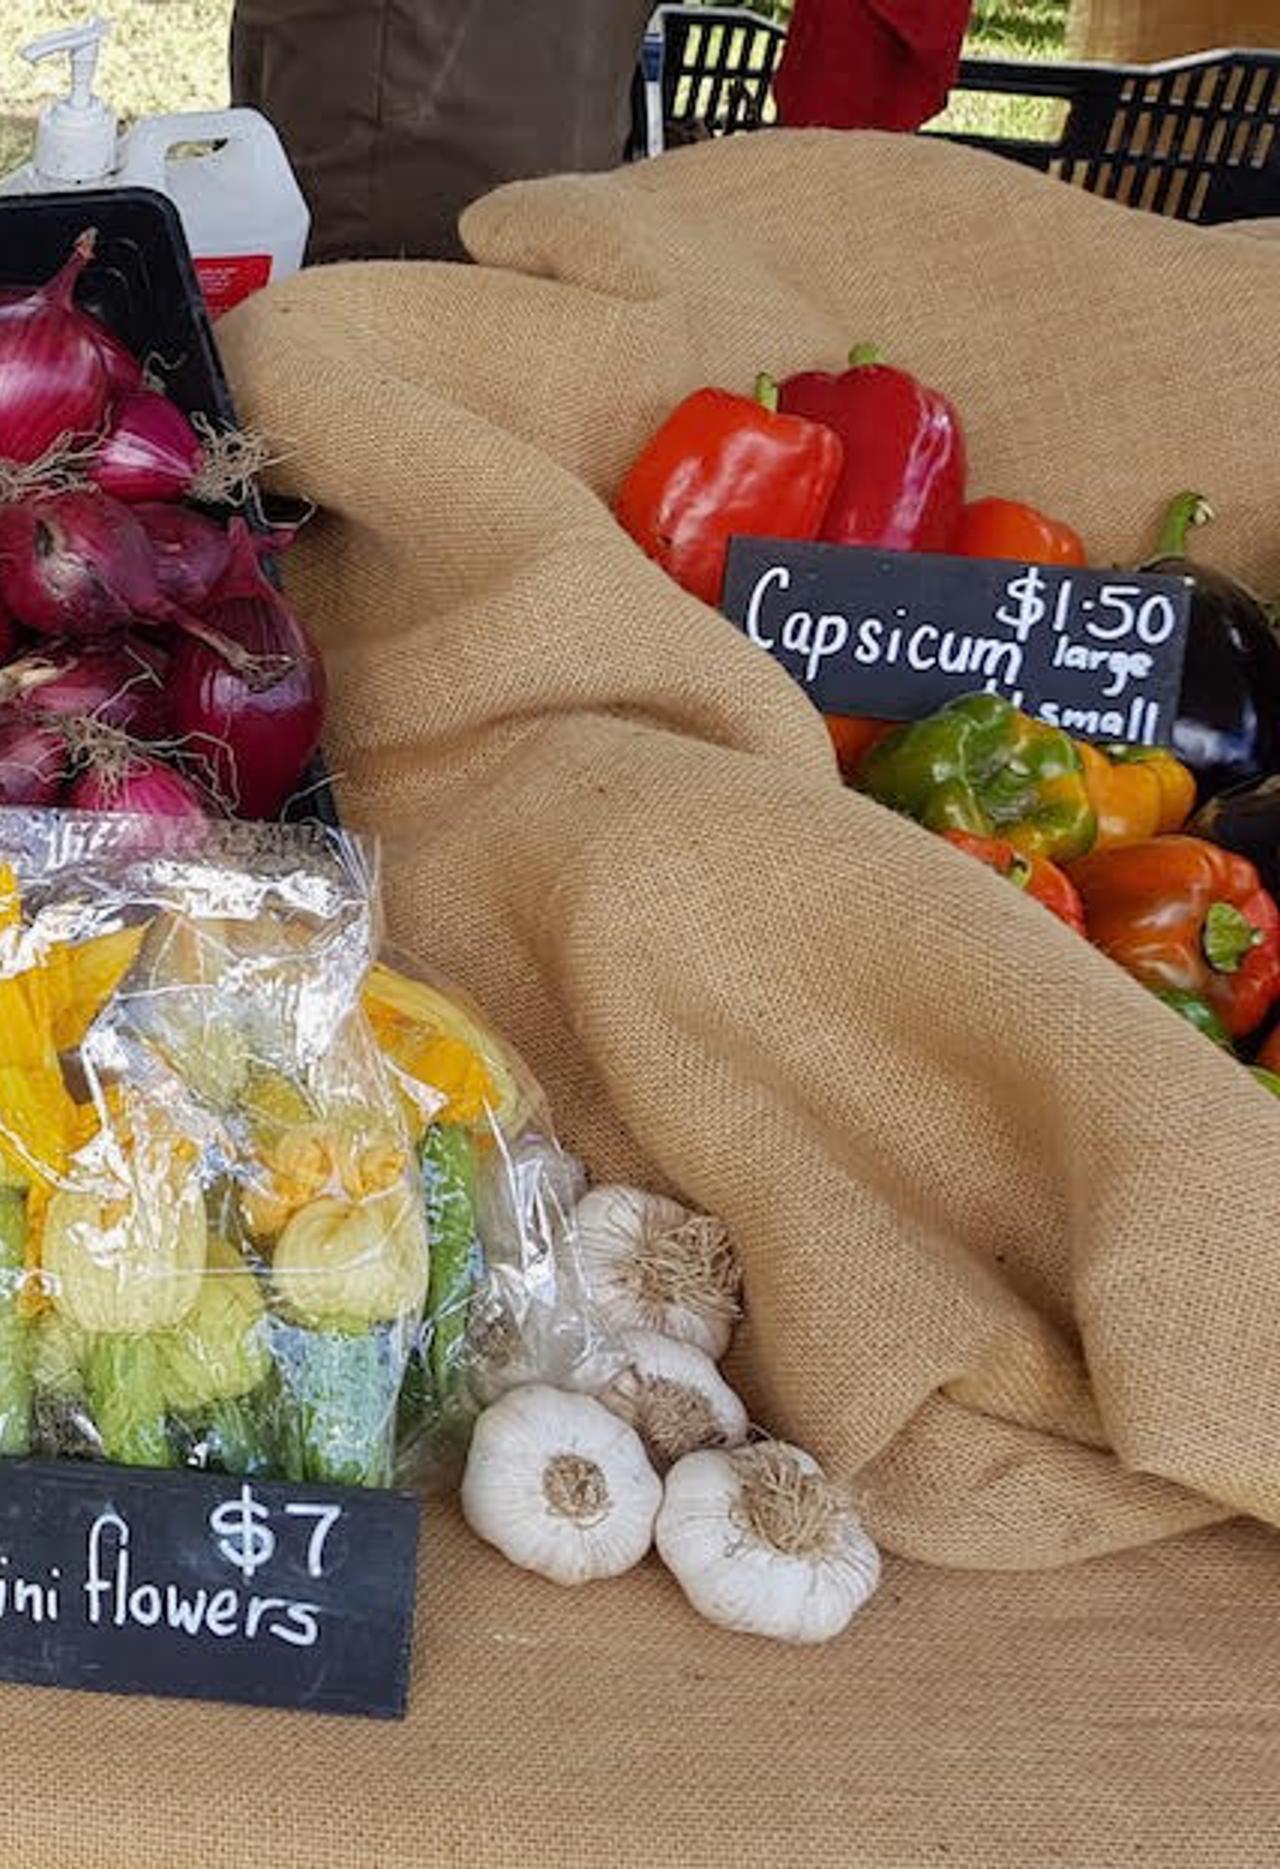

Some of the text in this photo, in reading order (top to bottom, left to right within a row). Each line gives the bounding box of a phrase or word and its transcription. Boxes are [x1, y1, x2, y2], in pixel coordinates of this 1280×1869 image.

[746, 566, 1025, 684] Capsicum
[1051, 635, 1154, 696] large
[1035, 696, 1160, 746] small
[82, 1513, 324, 1647] flowers
[209, 1483, 341, 1583] $7
